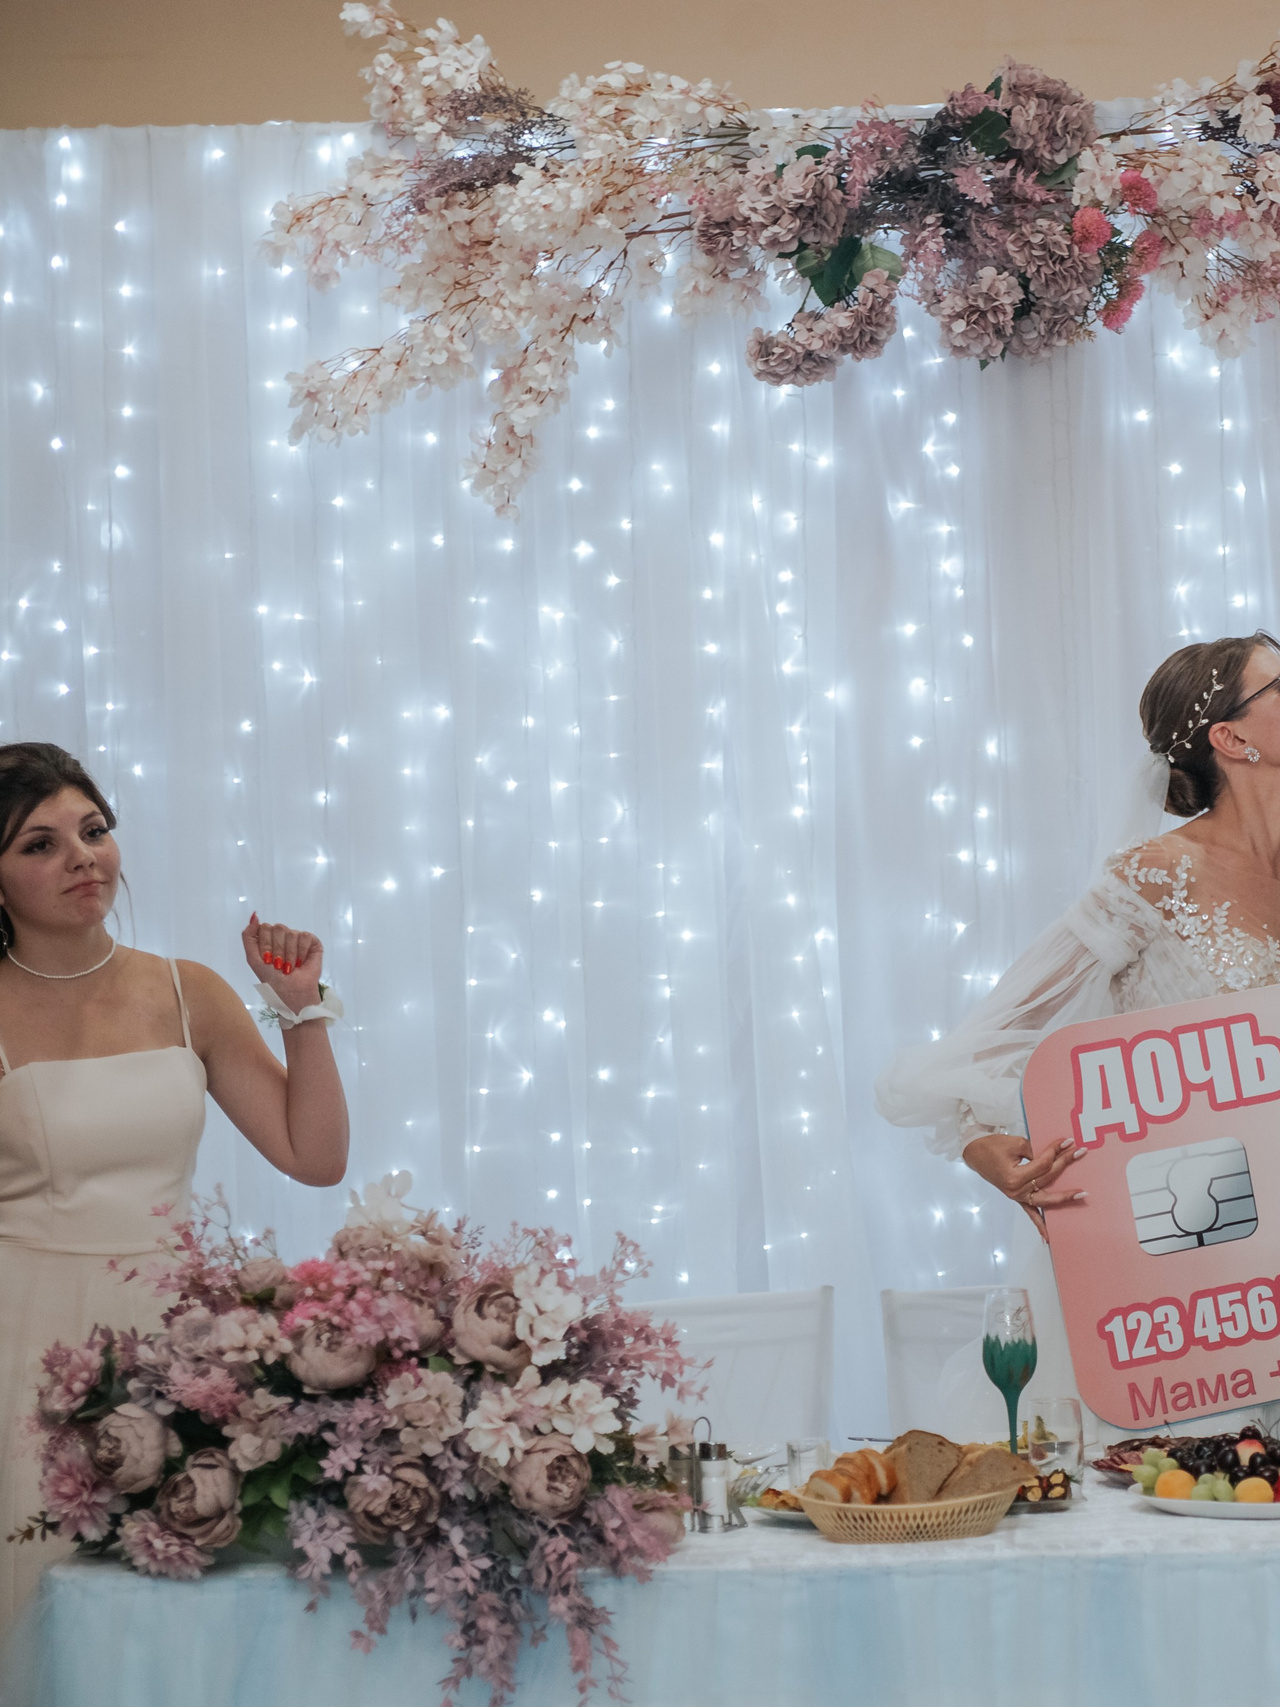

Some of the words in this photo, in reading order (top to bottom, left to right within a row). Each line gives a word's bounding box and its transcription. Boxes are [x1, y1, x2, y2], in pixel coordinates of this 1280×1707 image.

[1103, 1302, 1186, 1364] 123
[1192, 1284, 1279, 1345] 456
[1126, 1367, 1257, 1421] Мама
